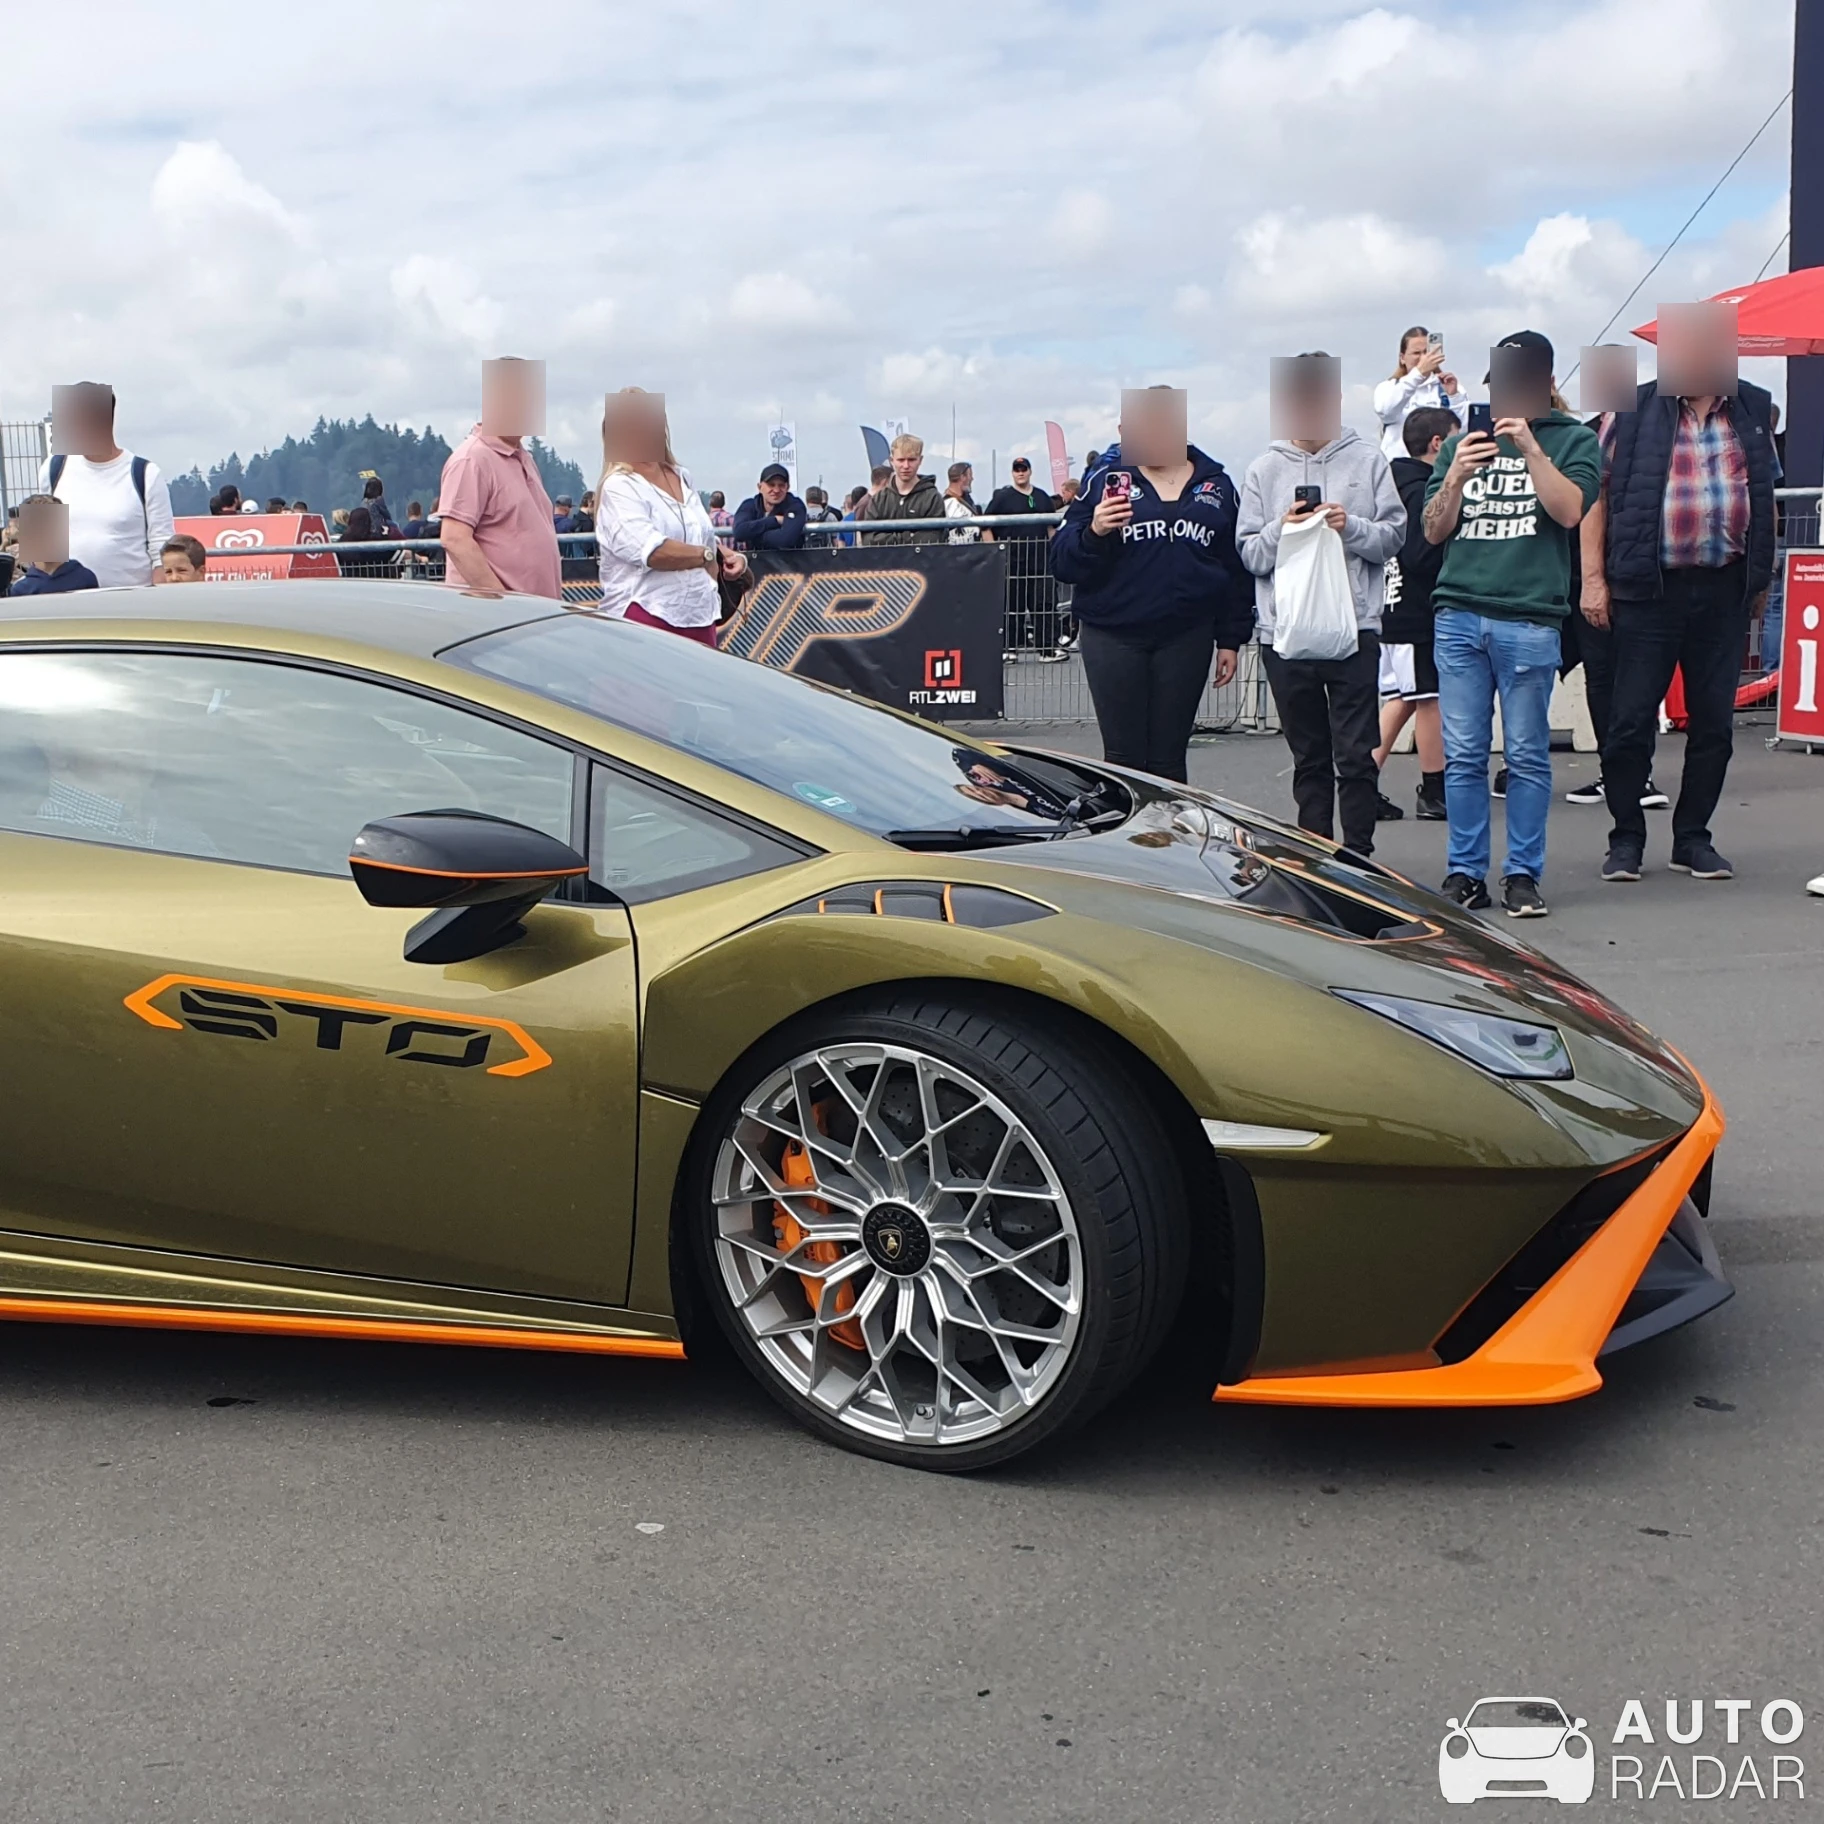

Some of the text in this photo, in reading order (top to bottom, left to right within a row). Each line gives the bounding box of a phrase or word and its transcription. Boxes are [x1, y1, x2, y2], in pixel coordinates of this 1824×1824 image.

[1455, 515, 1537, 540] MEHR
[909, 690, 977, 704] RTLZWEI
[179, 988, 492, 1068] STO
